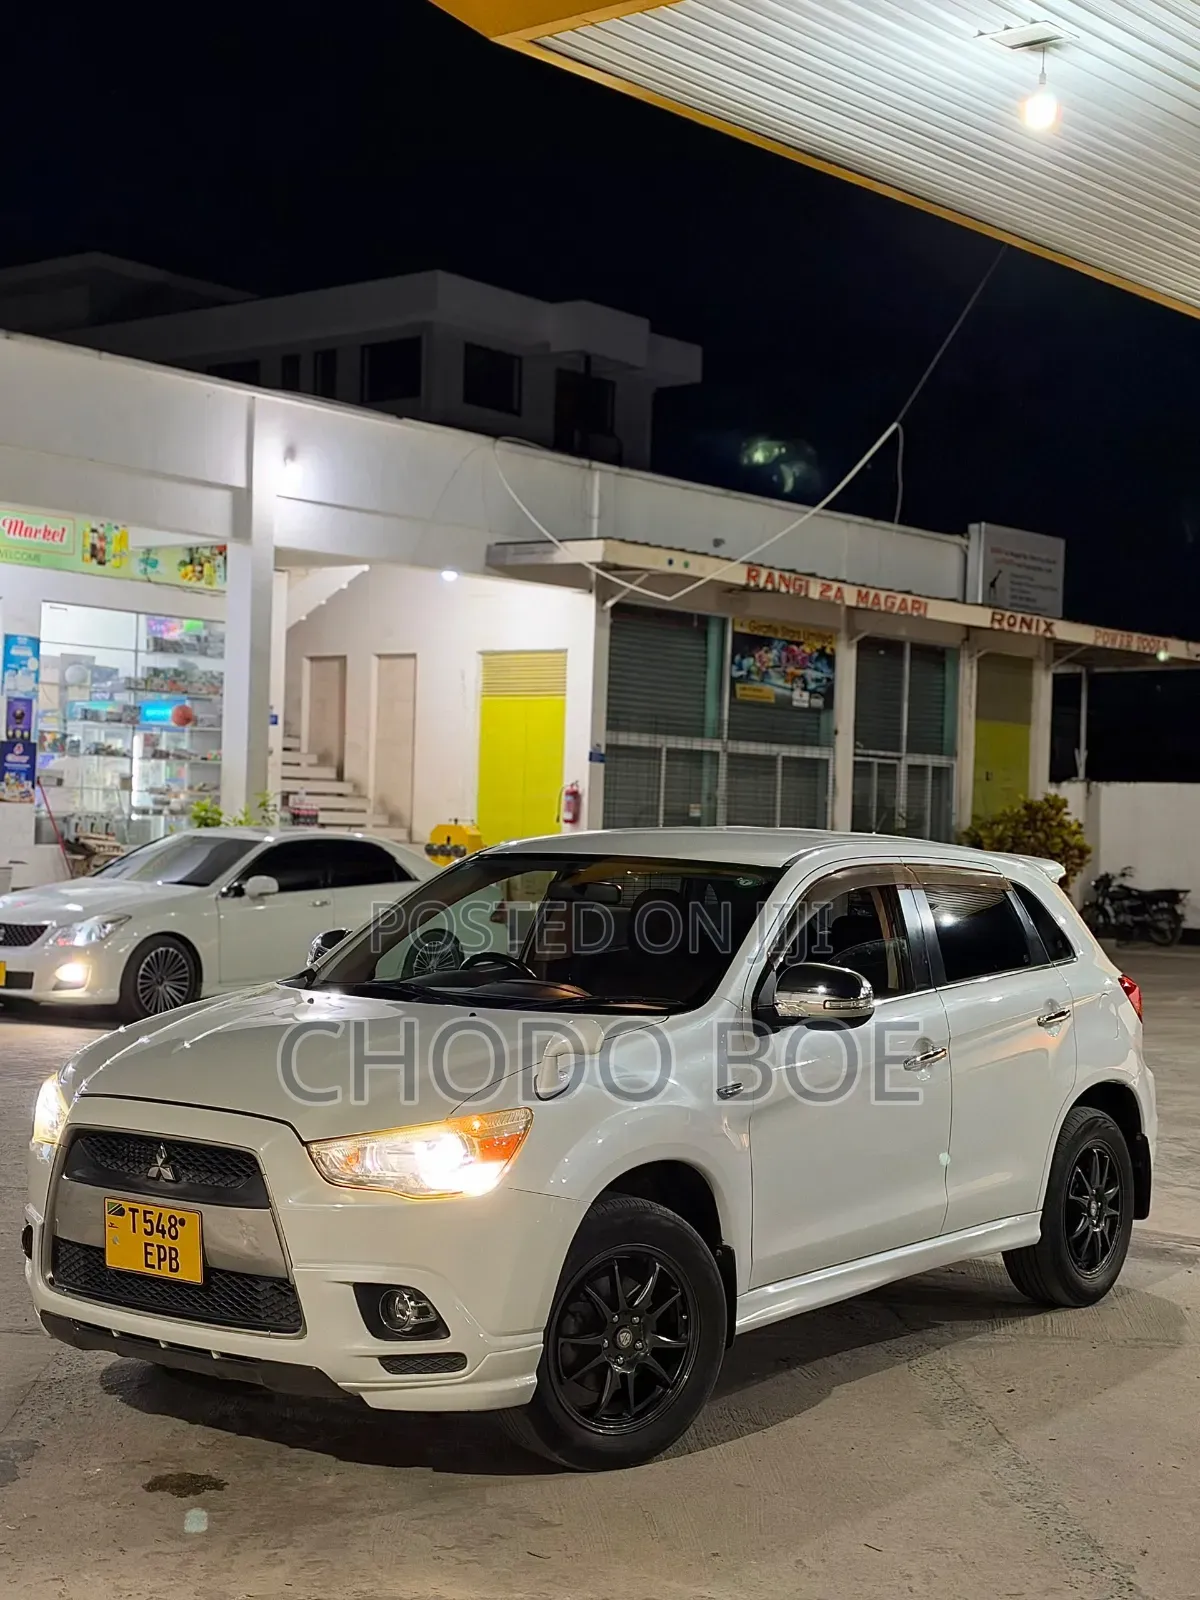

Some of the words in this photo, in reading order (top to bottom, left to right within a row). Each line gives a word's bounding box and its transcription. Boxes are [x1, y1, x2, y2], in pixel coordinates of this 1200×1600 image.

[1, 517, 66, 543] Market
[745, 566, 810, 597] RANGI
[818, 583, 845, 601] ZA
[855, 589, 929, 617] MAGARI
[990, 611, 1056, 637] RONIX
[143, 1241, 180, 1273] EPB
